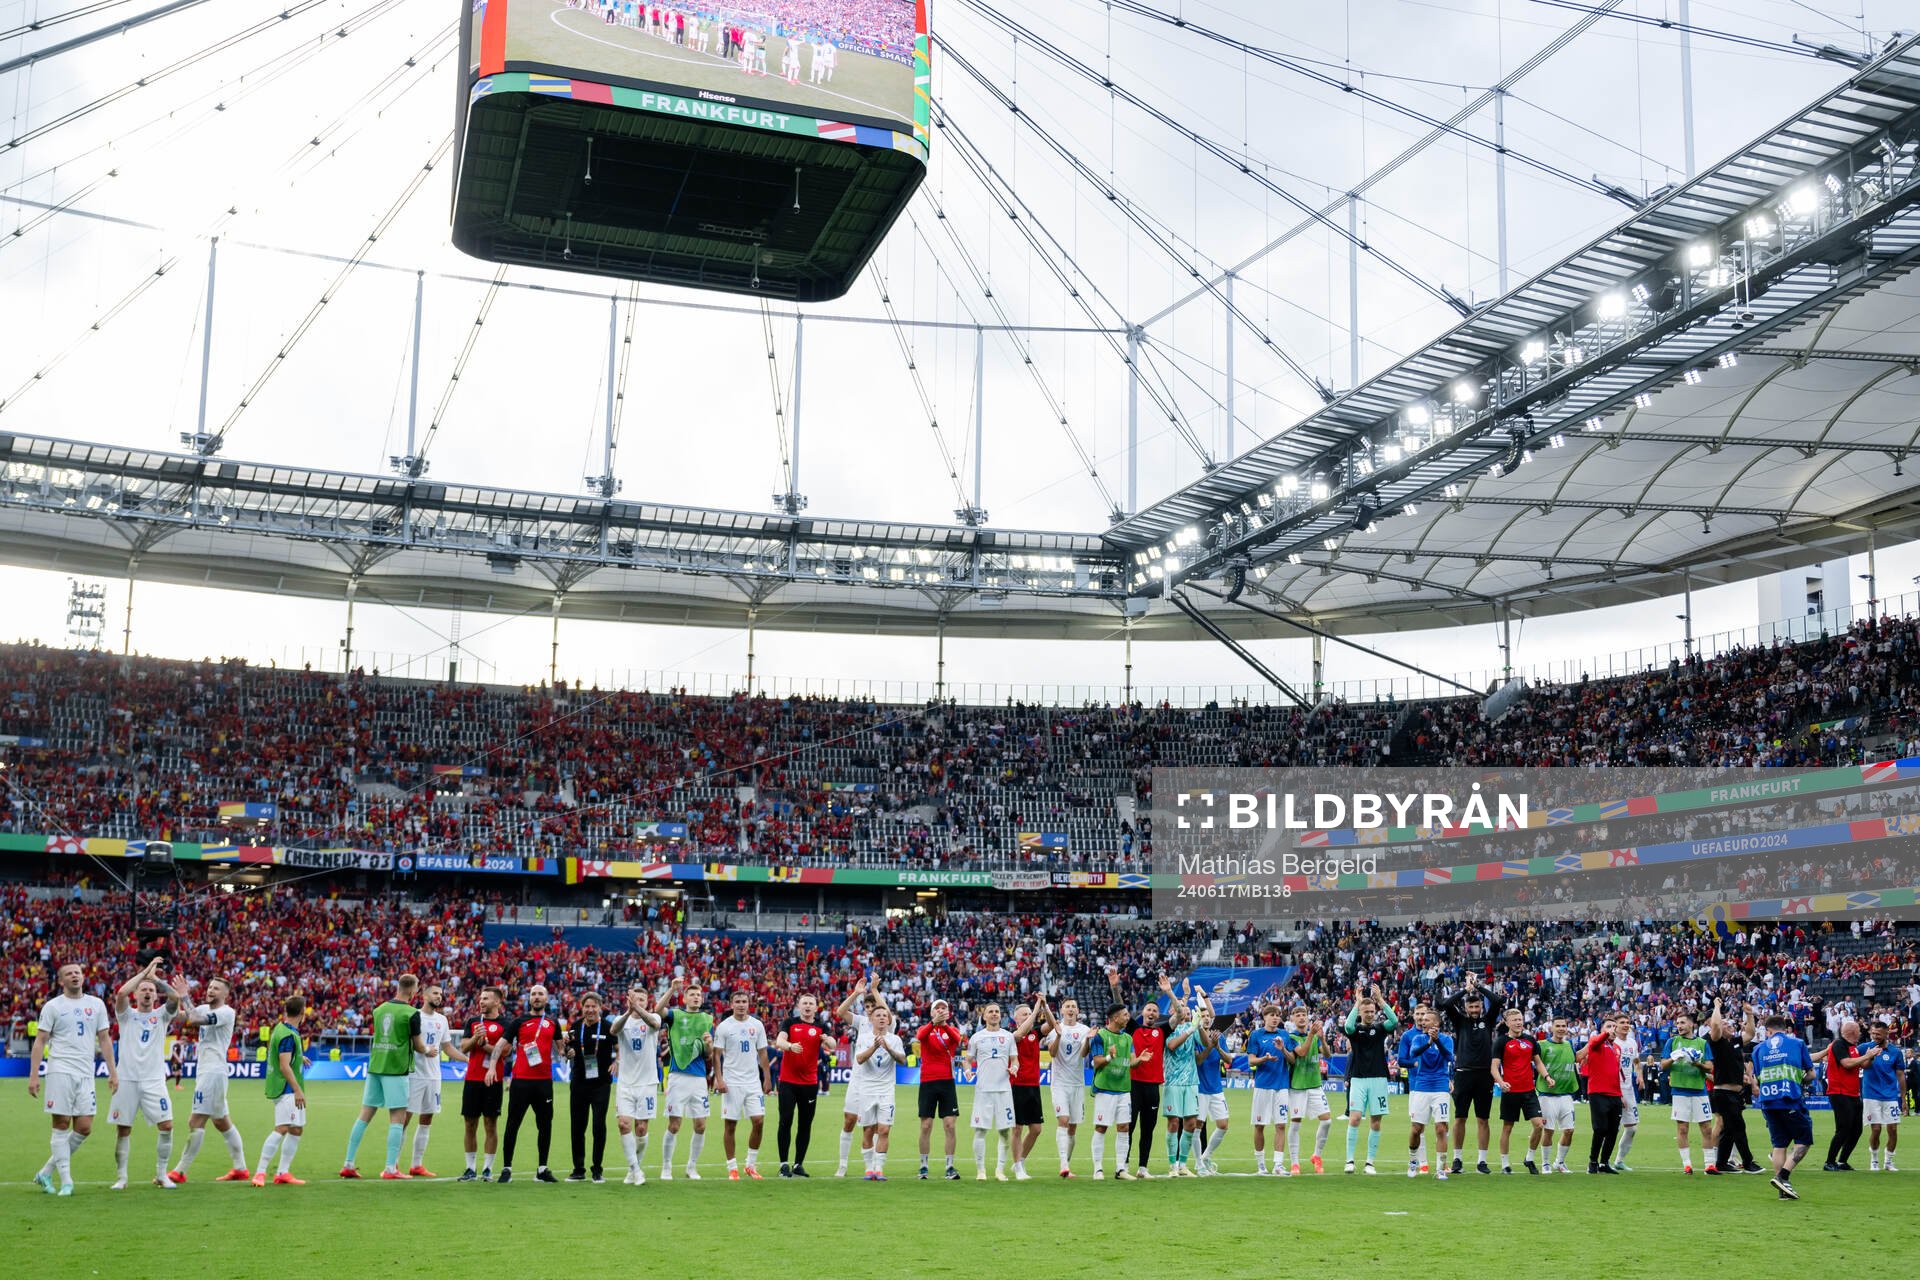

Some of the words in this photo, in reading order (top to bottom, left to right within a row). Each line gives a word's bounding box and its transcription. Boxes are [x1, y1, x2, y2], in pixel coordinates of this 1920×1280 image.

[838, 42, 876, 56] OFFICIAL
[699, 89, 736, 103] Hisense
[642, 93, 790, 130] FRANKFURT
[1711, 779, 1800, 802] FRANKFURT
[898, 872, 991, 886] FRANKFURT
[76, 1021, 85, 1036] 3
[631, 1038, 643, 1051] 19
[740, 1040, 750, 1053] 18
[1066, 1043, 1073, 1055] 9
[991, 1048, 998, 1058] 2
[160, 1097, 168, 1111] 8
[645, 1097, 655, 1111] 19
[1378, 1097, 1387, 1108] 12
[1439, 1103, 1448, 1115] 17
[1005, 1107, 1013, 1120] 2
